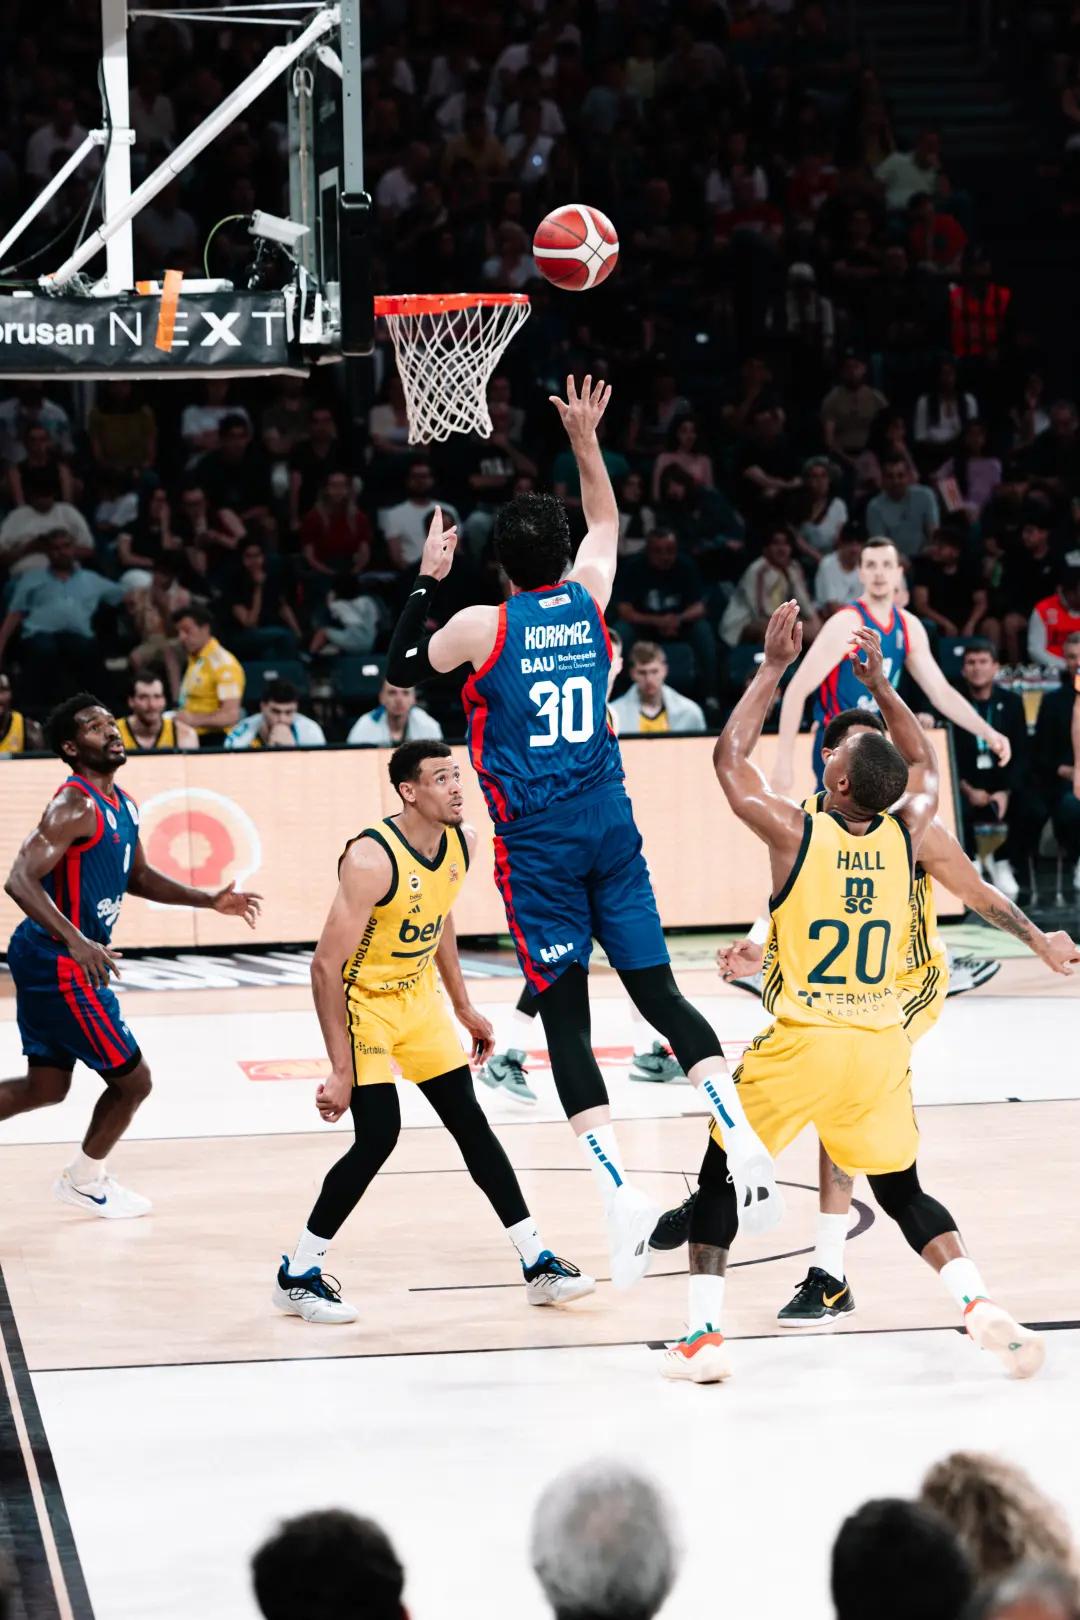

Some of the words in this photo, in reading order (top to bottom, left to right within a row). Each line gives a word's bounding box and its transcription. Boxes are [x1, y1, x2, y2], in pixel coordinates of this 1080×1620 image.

[109, 311, 286, 347] NEXT
[525, 620, 593, 650] KORKMAZ
[521, 656, 555, 674] BAU
[529, 675, 594, 748] 30
[837, 850, 886, 871] HALL
[352, 916, 378, 968] HOLDING
[808, 919, 892, 985] 20
